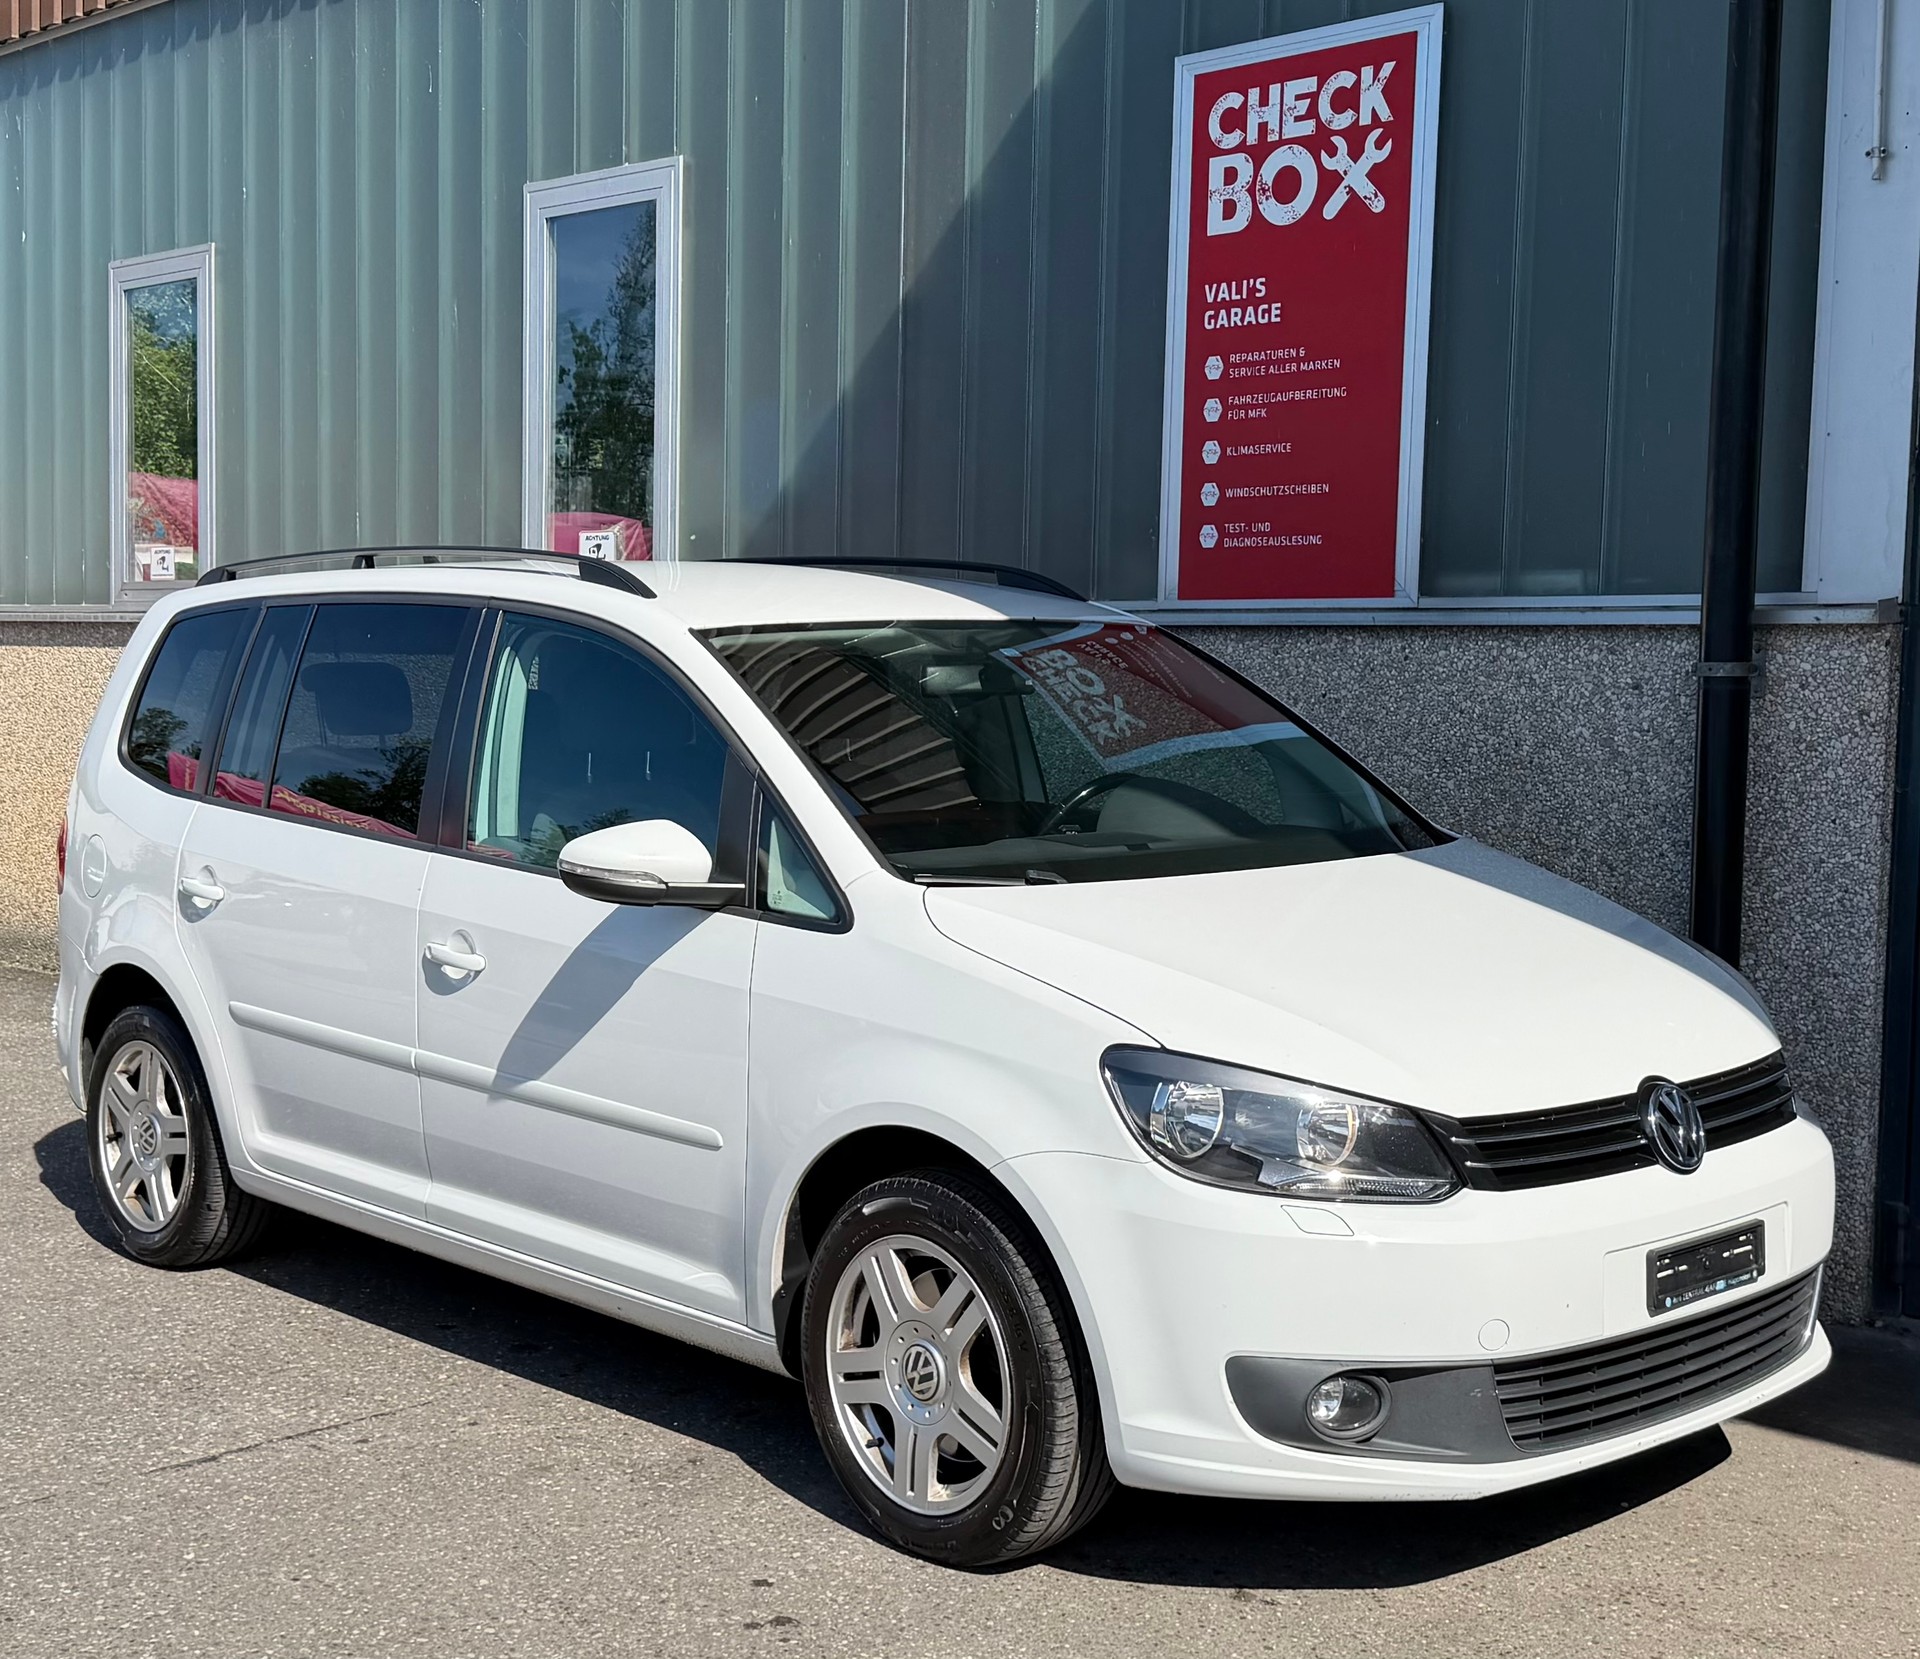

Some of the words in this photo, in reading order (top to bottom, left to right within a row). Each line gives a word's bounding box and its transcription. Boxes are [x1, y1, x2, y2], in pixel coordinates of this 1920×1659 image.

[1208, 60, 1397, 150] CHECK
[1204, 277, 1267, 304] VALI'S
[1203, 302, 1282, 330] GARAGE
[1229, 347, 1297, 364] REPARATUREN
[1298, 346, 1306, 357] &
[1229, 365, 1266, 379] SERVICE
[1268, 362, 1298, 375] ALLER
[1300, 358, 1341, 371] MARKEN
[1228, 386, 1347, 406] FAHRZEUGAUFBEREITUNG
[1227, 408, 1246, 421] FÜR
[1247, 407, 1268, 419] MFK
[1226, 442, 1292, 457] KLIMASERVICE
[1225, 483, 1330, 498] WINDSCHUTZSCHEIBEN
[1224, 522, 1249, 534] TEST-
[1251, 521, 1271, 533] UND
[1223, 534, 1323, 548] DIAGNOSEAUSLESUNG
